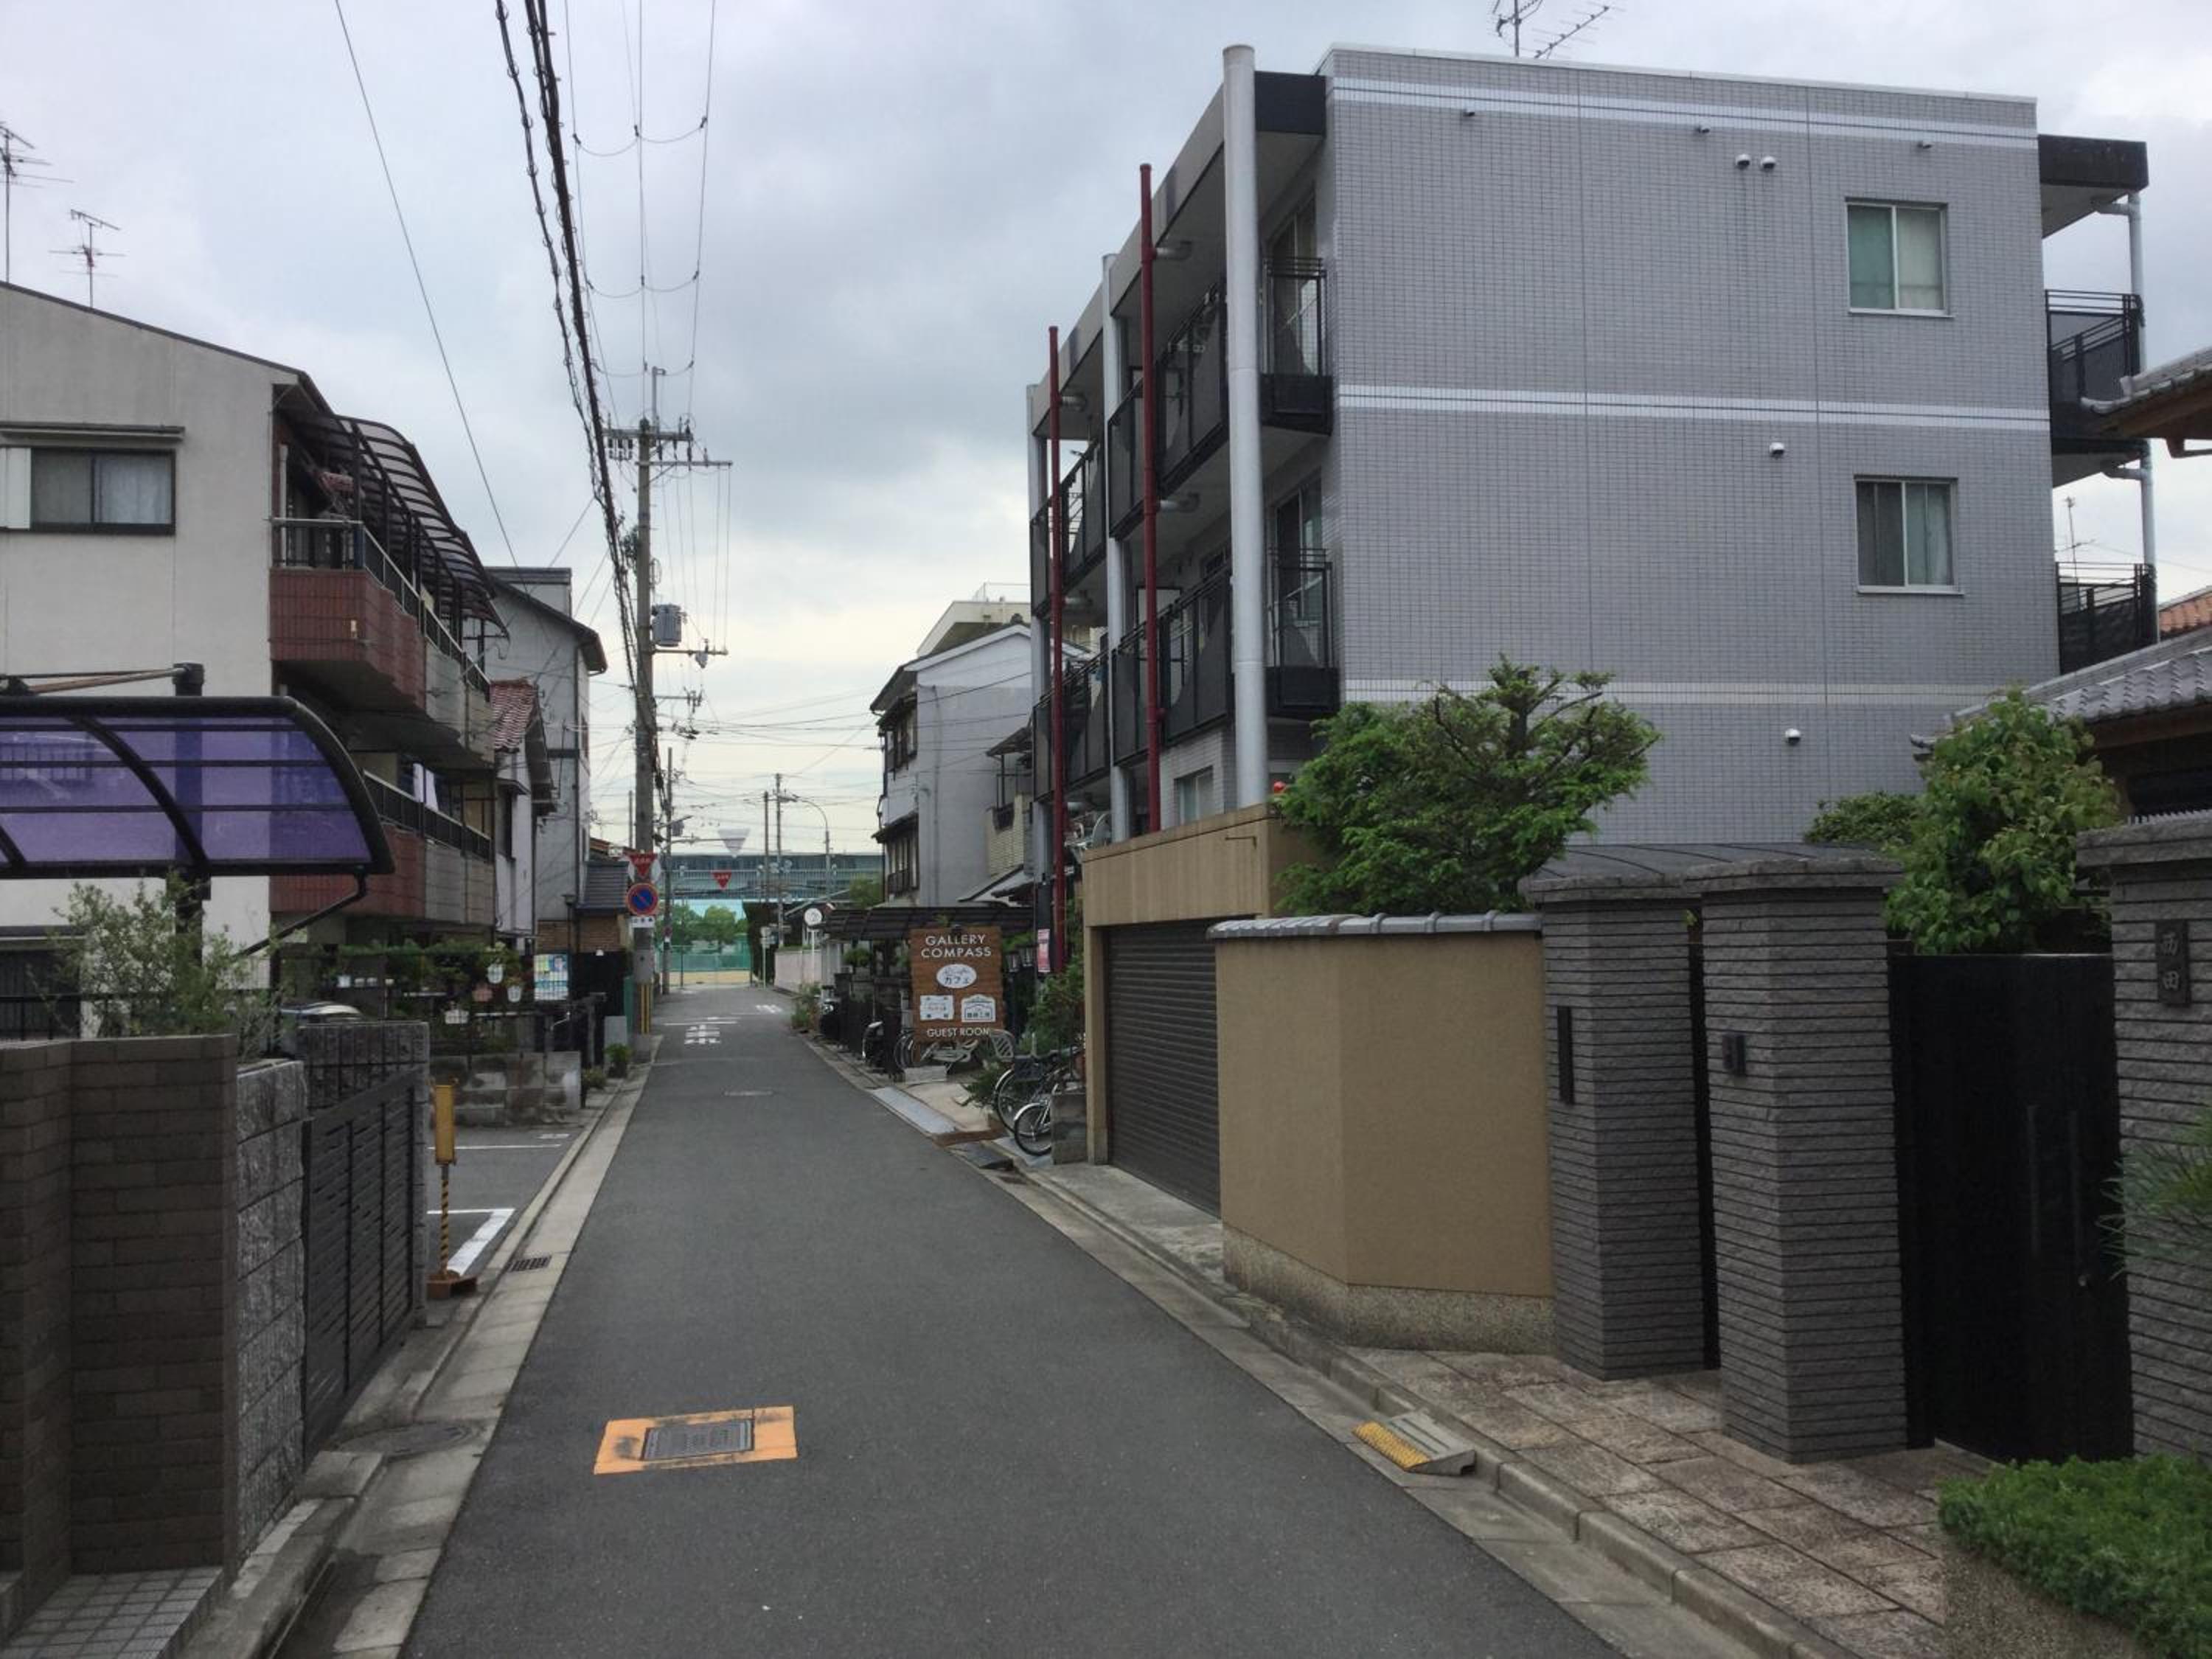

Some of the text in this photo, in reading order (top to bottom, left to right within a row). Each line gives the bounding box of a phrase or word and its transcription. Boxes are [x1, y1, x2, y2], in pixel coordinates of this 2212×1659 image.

[925, 934, 986, 946] GALLERY
[921, 947, 992, 959] COMPASS
[927, 1027, 957, 1038] GUEST
